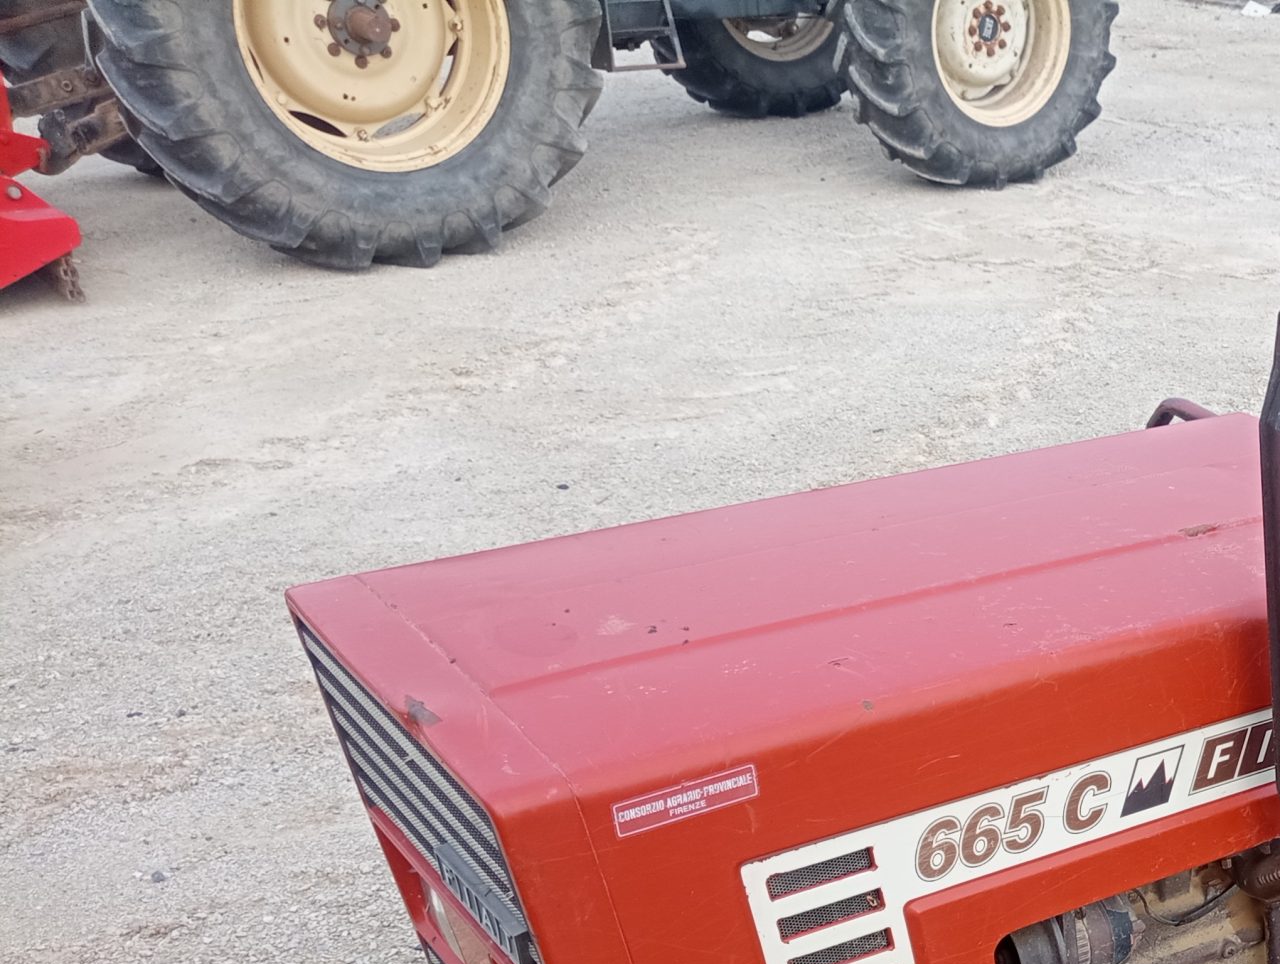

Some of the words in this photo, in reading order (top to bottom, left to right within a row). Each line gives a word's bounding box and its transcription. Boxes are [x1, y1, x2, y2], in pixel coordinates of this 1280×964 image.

[618, 799, 665, 823] CONSORZIO
[669, 799, 707, 817] FIRENZE
[915, 785, 1050, 882] 665
[1063, 770, 1112, 834] C
[442, 858, 516, 962] FIAT
